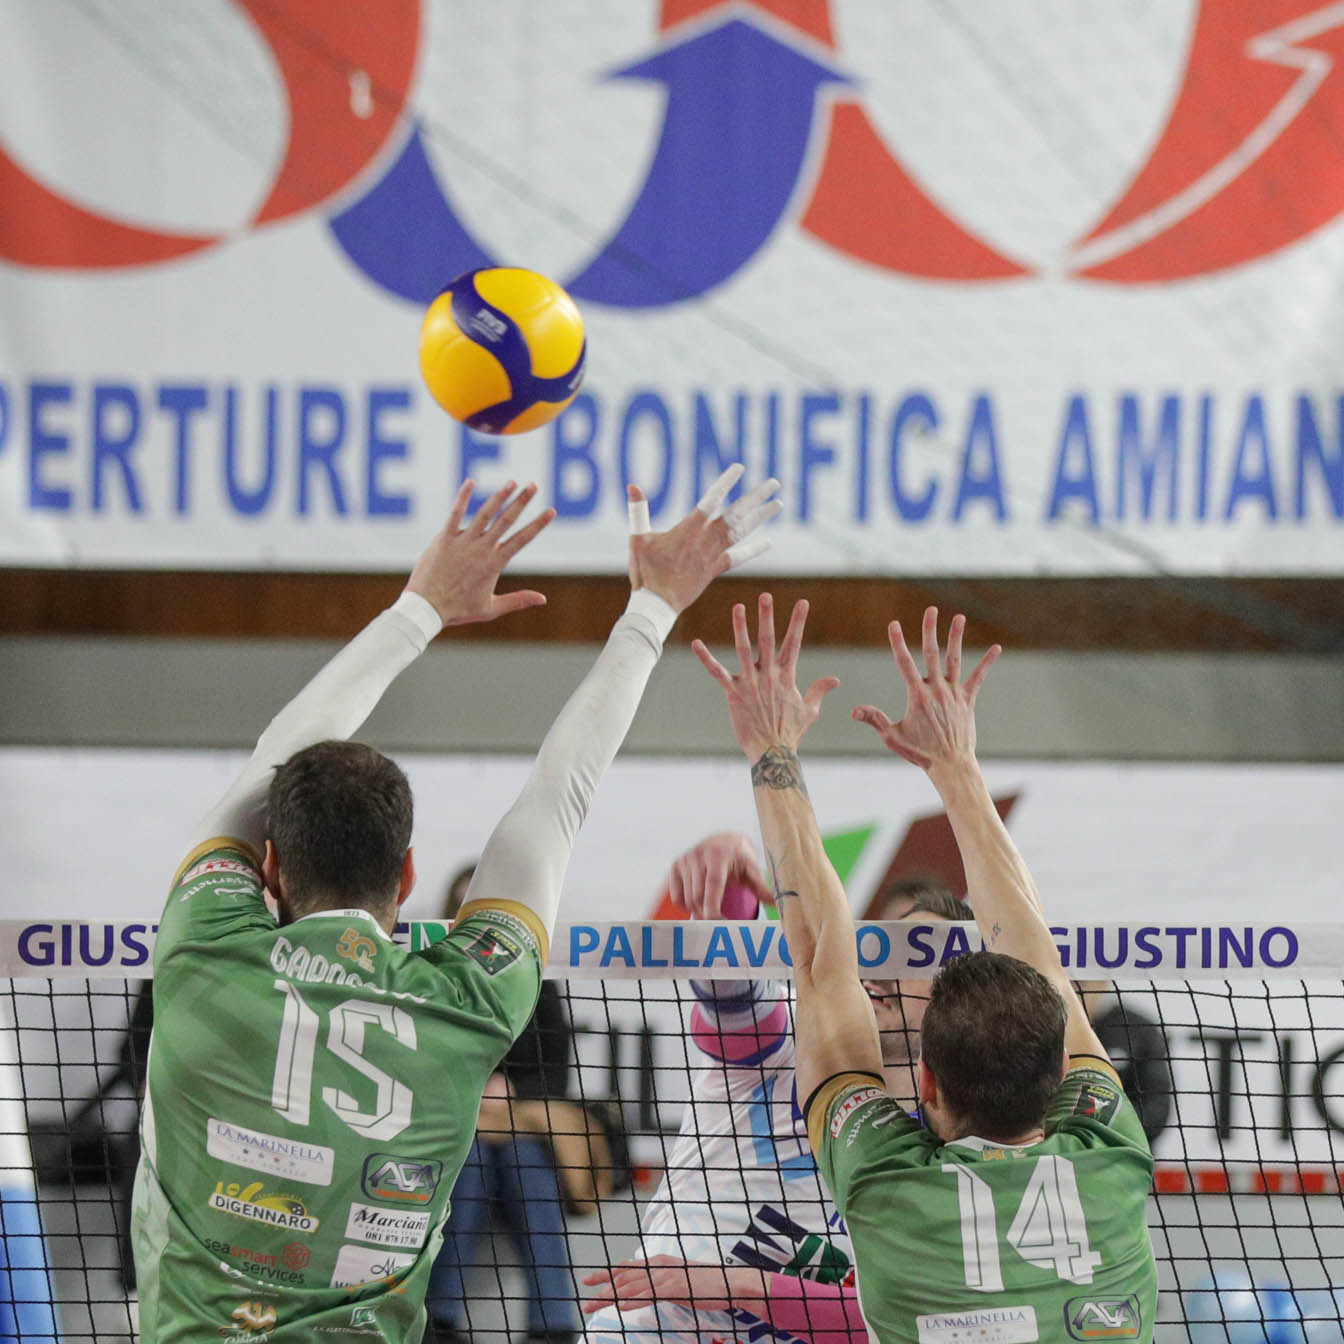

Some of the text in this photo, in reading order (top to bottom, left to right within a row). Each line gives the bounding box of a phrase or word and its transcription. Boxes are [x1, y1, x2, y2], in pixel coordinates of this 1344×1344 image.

[547, 389, 1008, 529] BONIFICA
[271, 979, 418, 1142] 15
[236, 1131, 324, 1162] MARINELLA
[941, 1155, 1103, 1293] 14
[242, 1259, 305, 1285] services
[944, 1311, 1026, 1328] MARINELLA
